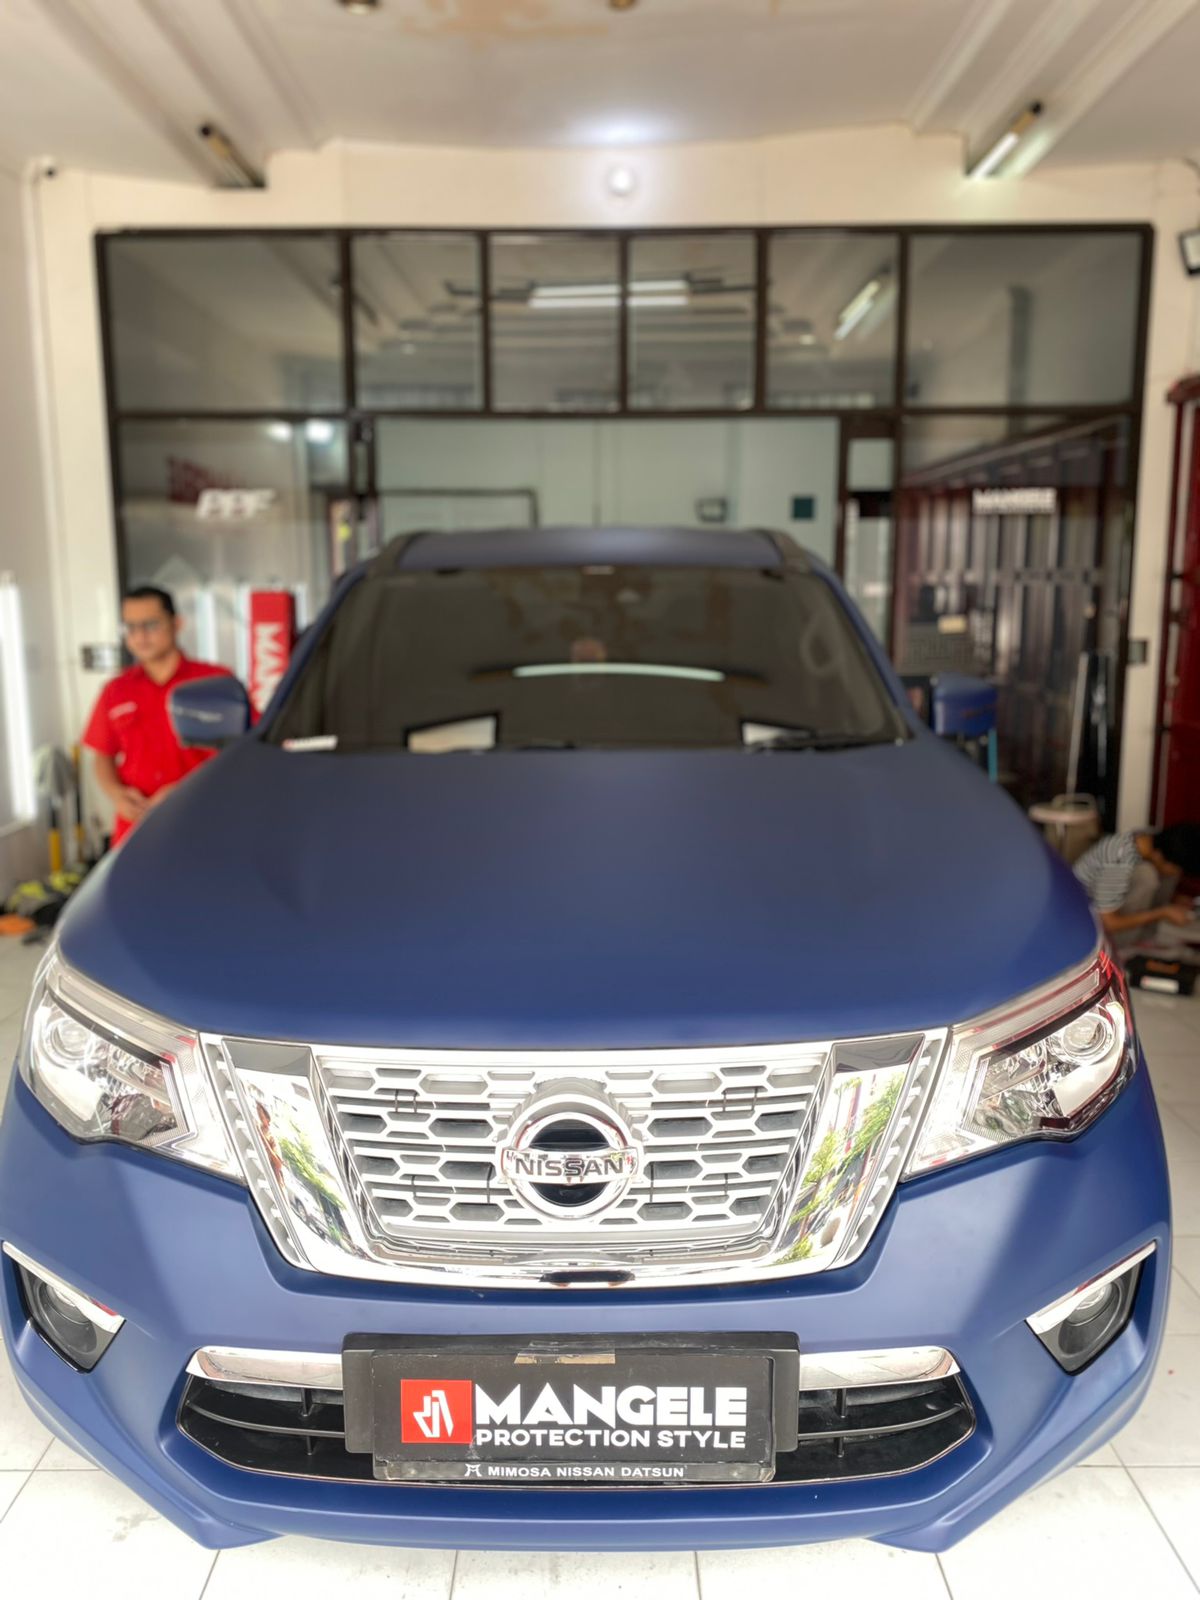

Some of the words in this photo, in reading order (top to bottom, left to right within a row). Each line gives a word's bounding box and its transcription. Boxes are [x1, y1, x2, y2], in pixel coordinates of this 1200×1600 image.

[514, 1157, 623, 1176] NISSAN
[475, 1382, 747, 1429] MANGELE
[476, 1428, 650, 1447] PROTECTION
[657, 1430, 746, 1448] STYLE
[488, 1466, 551, 1477] MIMOSA
[557, 1467, 615, 1477] NISSAN
[621, 1467, 684, 1477] DATSUN
